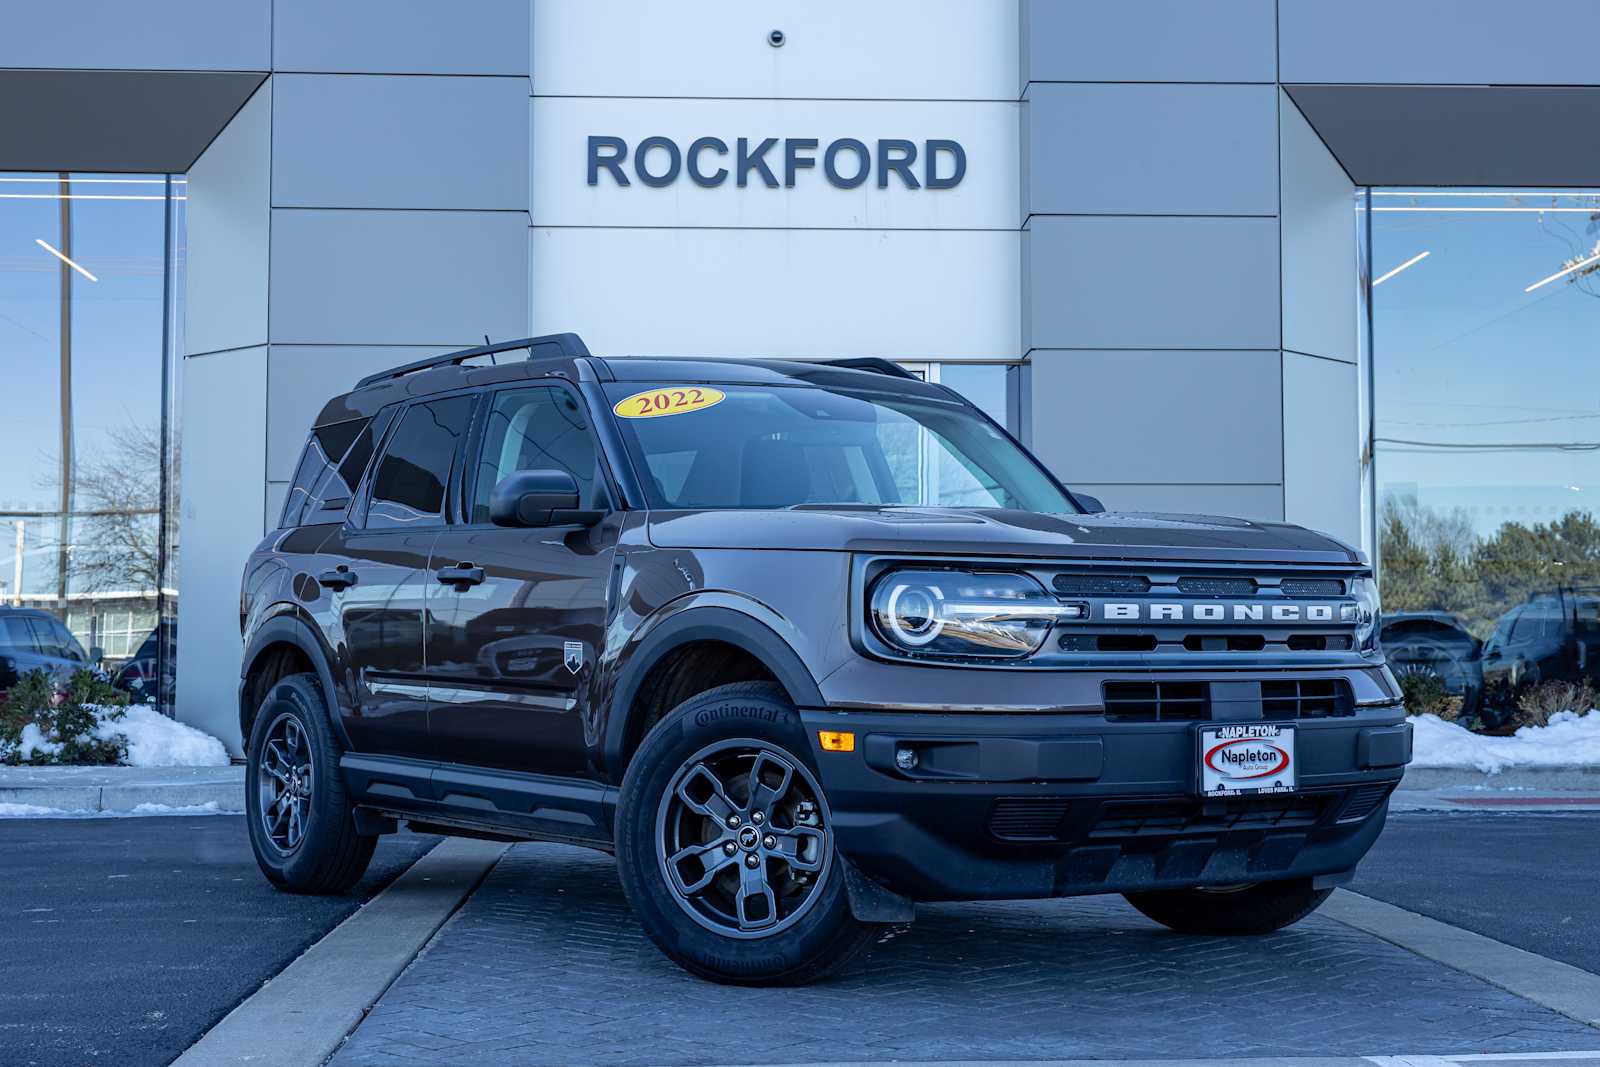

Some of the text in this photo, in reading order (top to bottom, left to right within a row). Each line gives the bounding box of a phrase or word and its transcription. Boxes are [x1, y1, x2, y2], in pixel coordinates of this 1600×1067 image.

[587, 135, 967, 189] ROCKFORD
[636, 389, 705, 414] 2022
[1104, 603, 1332, 620] BRONCO
[695, 703, 778, 728] Continental
[1221, 725, 1276, 738] NAPLETON
[1221, 749, 1277, 765] Napleton
